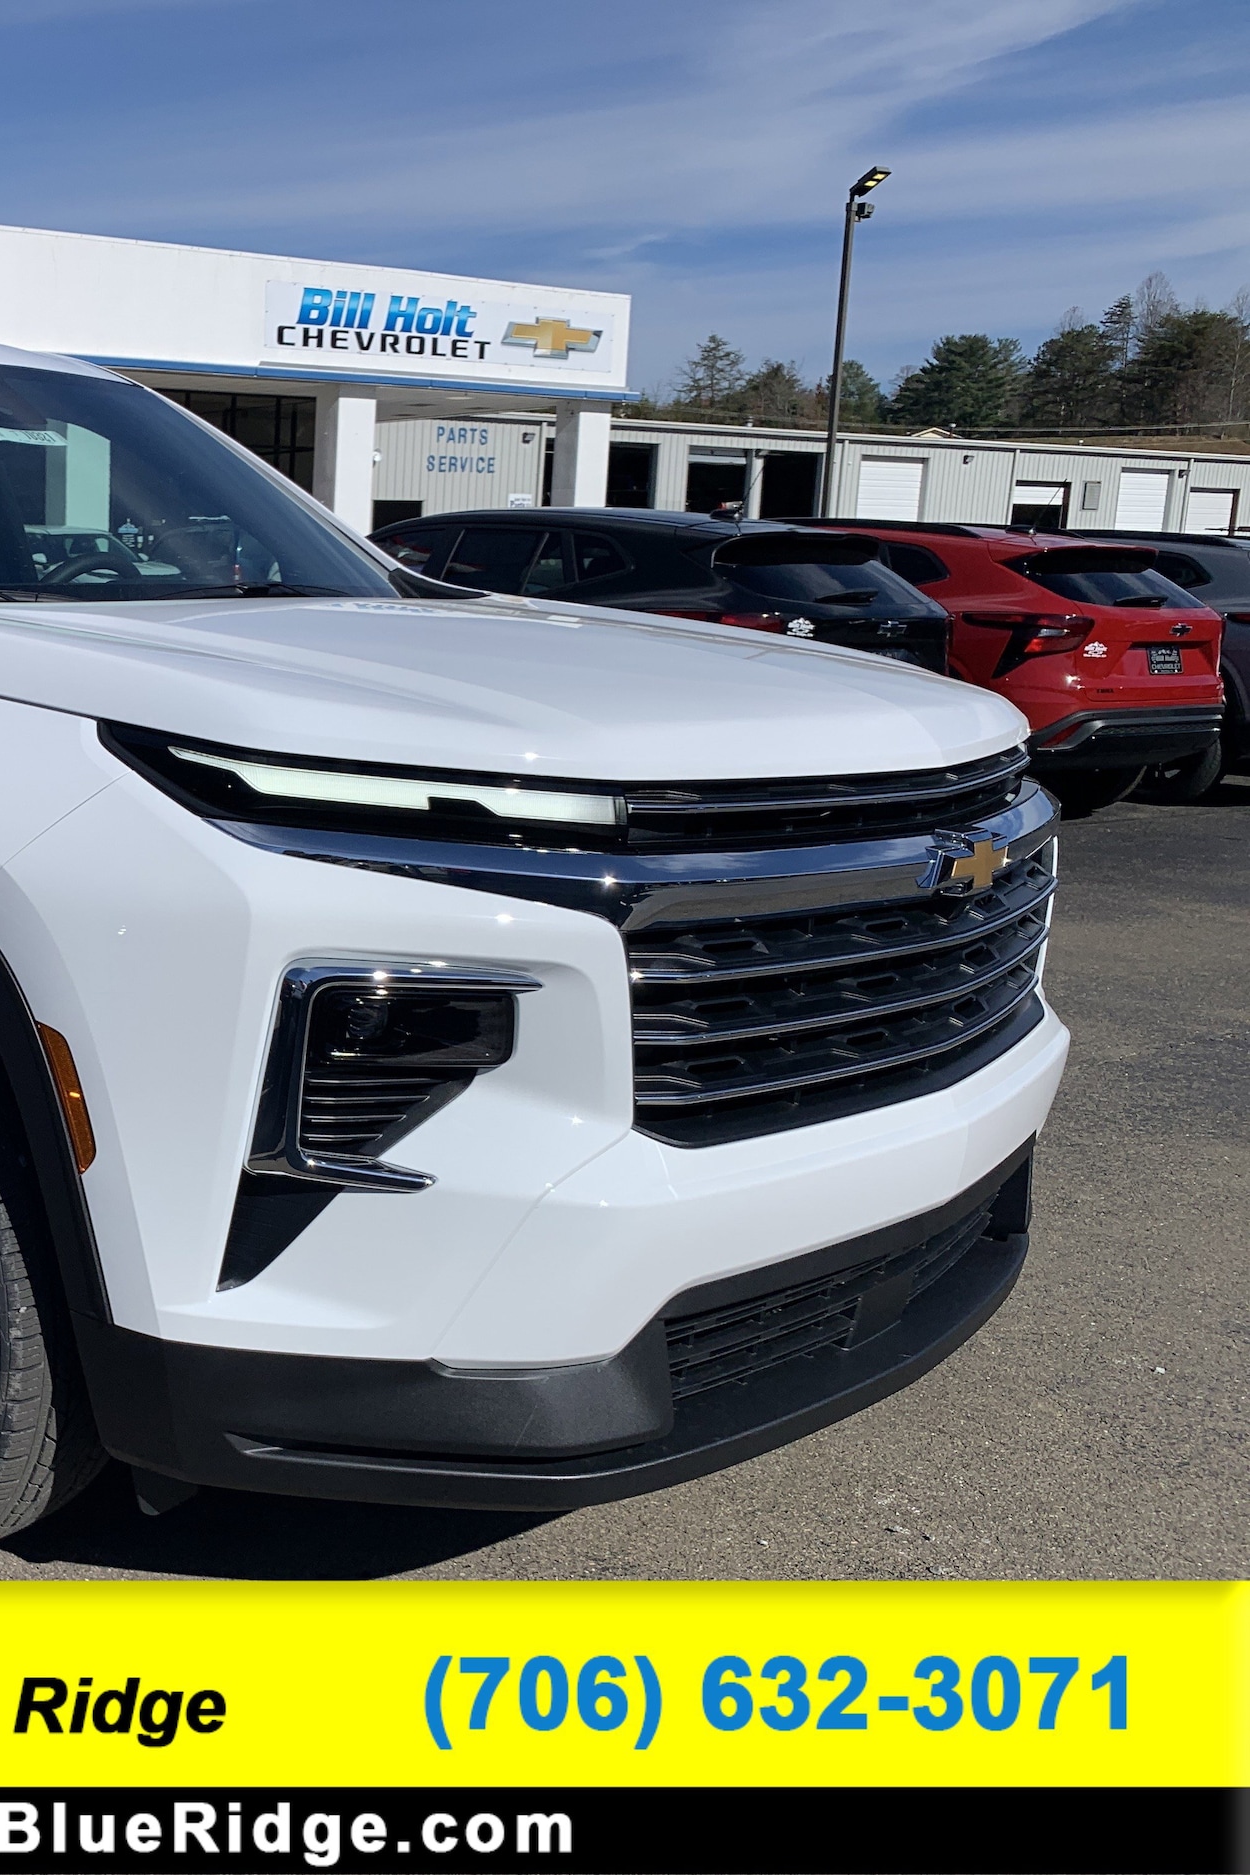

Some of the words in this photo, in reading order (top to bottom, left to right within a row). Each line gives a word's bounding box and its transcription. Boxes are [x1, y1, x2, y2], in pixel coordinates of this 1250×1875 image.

[296, 287, 376, 330] Bill
[384, 294, 477, 338] Holt
[277, 325, 491, 360] CHEVROLET
[436, 425, 489, 446] PARTS
[426, 454, 496, 474] SERVICE
